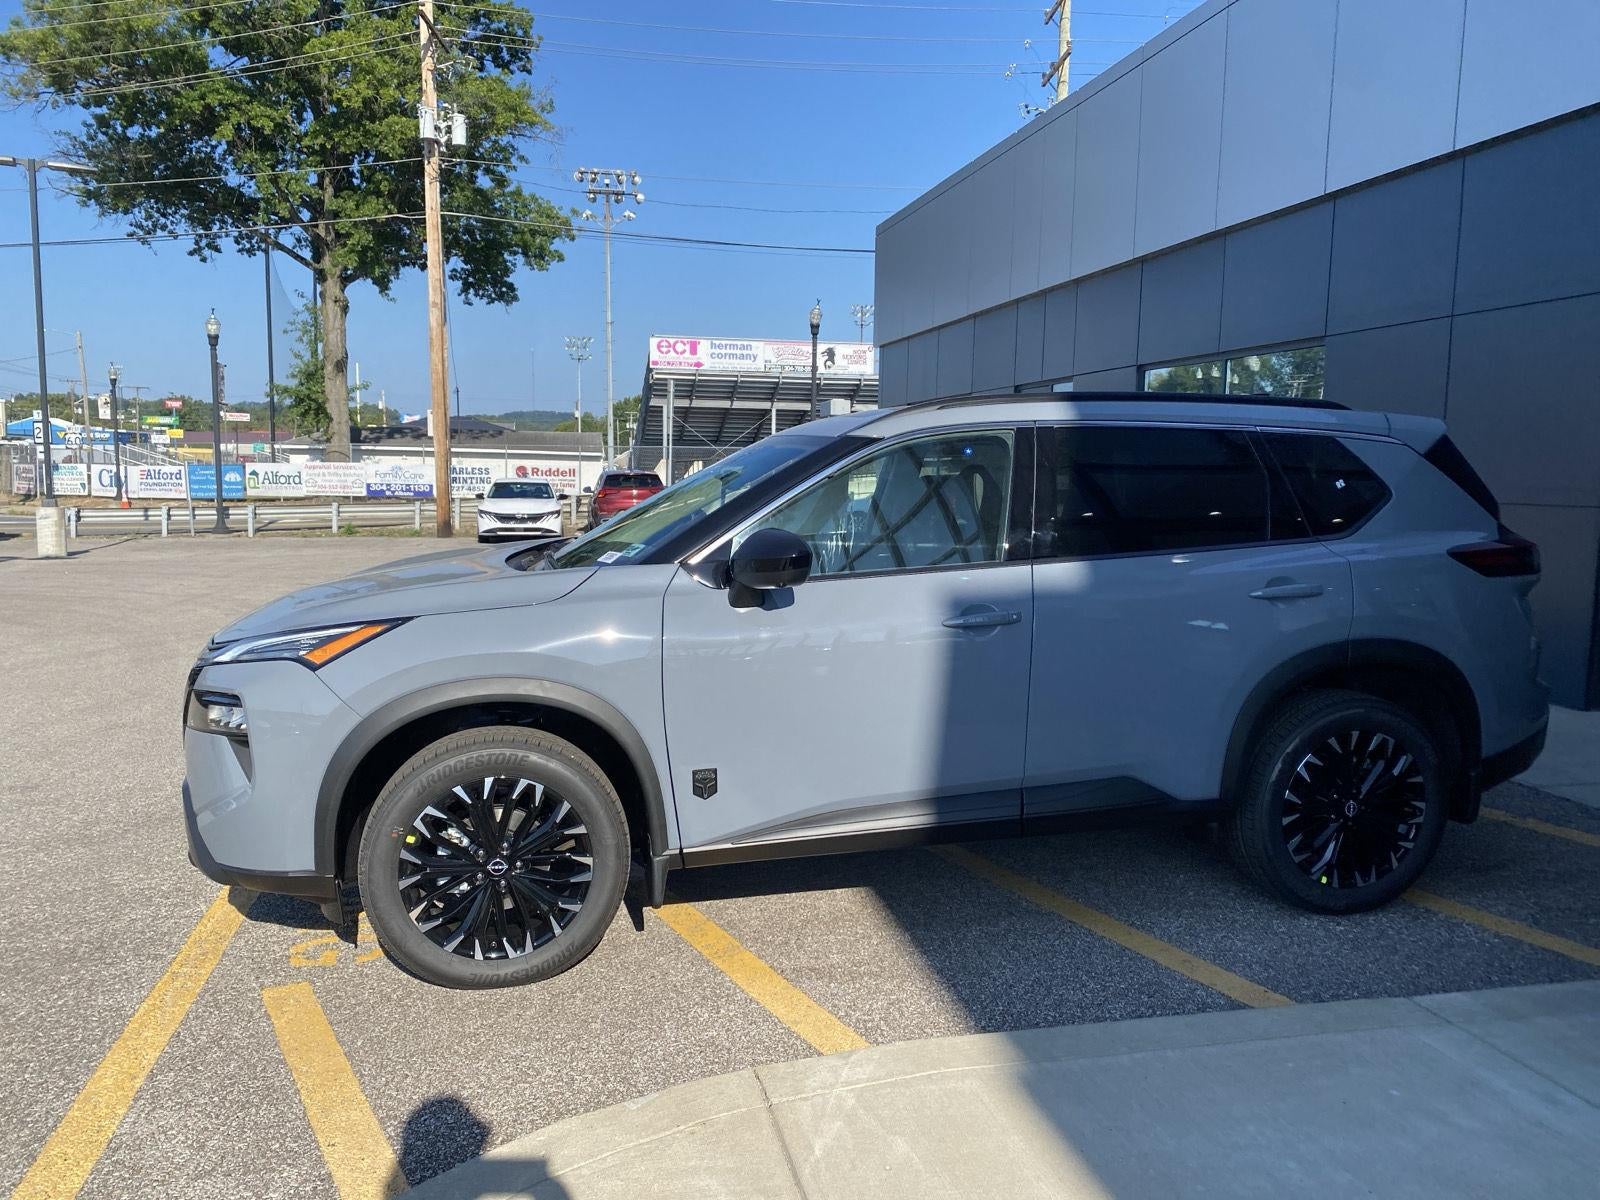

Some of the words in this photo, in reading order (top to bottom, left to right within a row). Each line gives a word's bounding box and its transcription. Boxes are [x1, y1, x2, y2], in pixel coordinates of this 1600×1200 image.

[710, 340, 753, 352] herman
[710, 351, 758, 363] cormany
[67, 436, 81, 446] 60
[94, 432, 111, 441] SHOP
[146, 469, 182, 480] Alford
[451, 467, 490, 475] ARLESS
[531, 467, 576, 478] Riddell
[262, 470, 302, 485] Alford
[451, 476, 492, 485] RINTING
[412, 752, 530, 797] BRIDGESTONE
